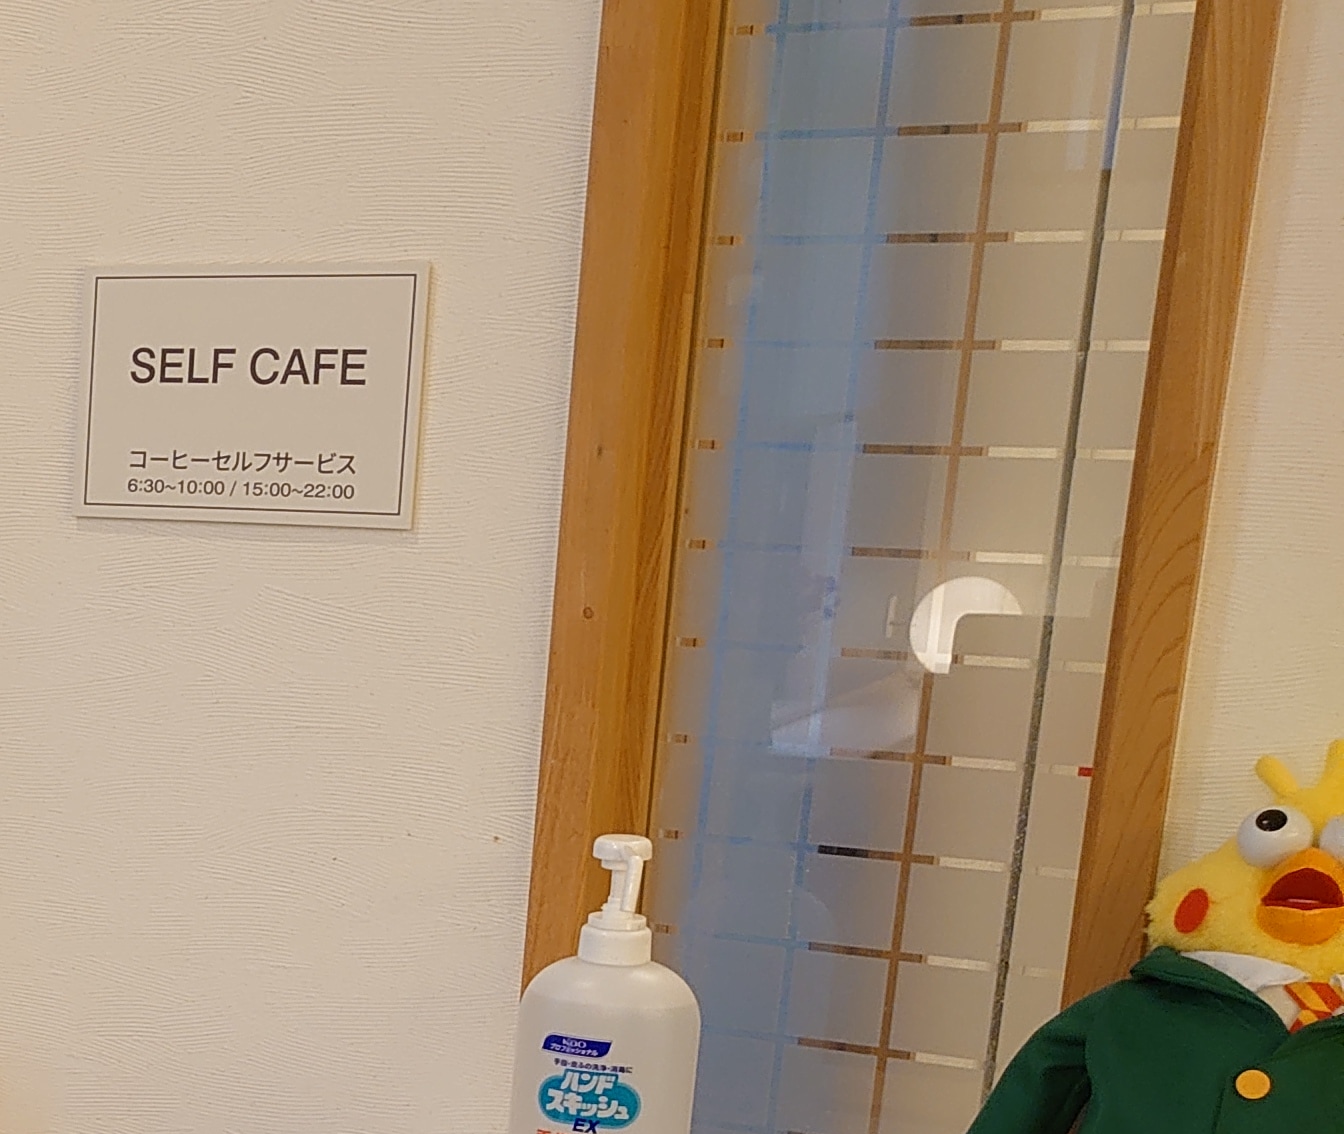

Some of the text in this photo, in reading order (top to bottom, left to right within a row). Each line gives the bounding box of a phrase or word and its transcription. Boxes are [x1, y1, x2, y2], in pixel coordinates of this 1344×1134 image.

[130, 347, 368, 386] SELF CAFE
[129, 450, 357, 475] コーヒーセルフサービス
[127, 478, 225, 496] 6:30~10:00
[243, 481, 355, 500] 15:00~22:00
[560, 1071, 616, 1095] ハンド
[545, 1088, 630, 1120] スキッシュ
[572, 1117, 601, 1134] EX
